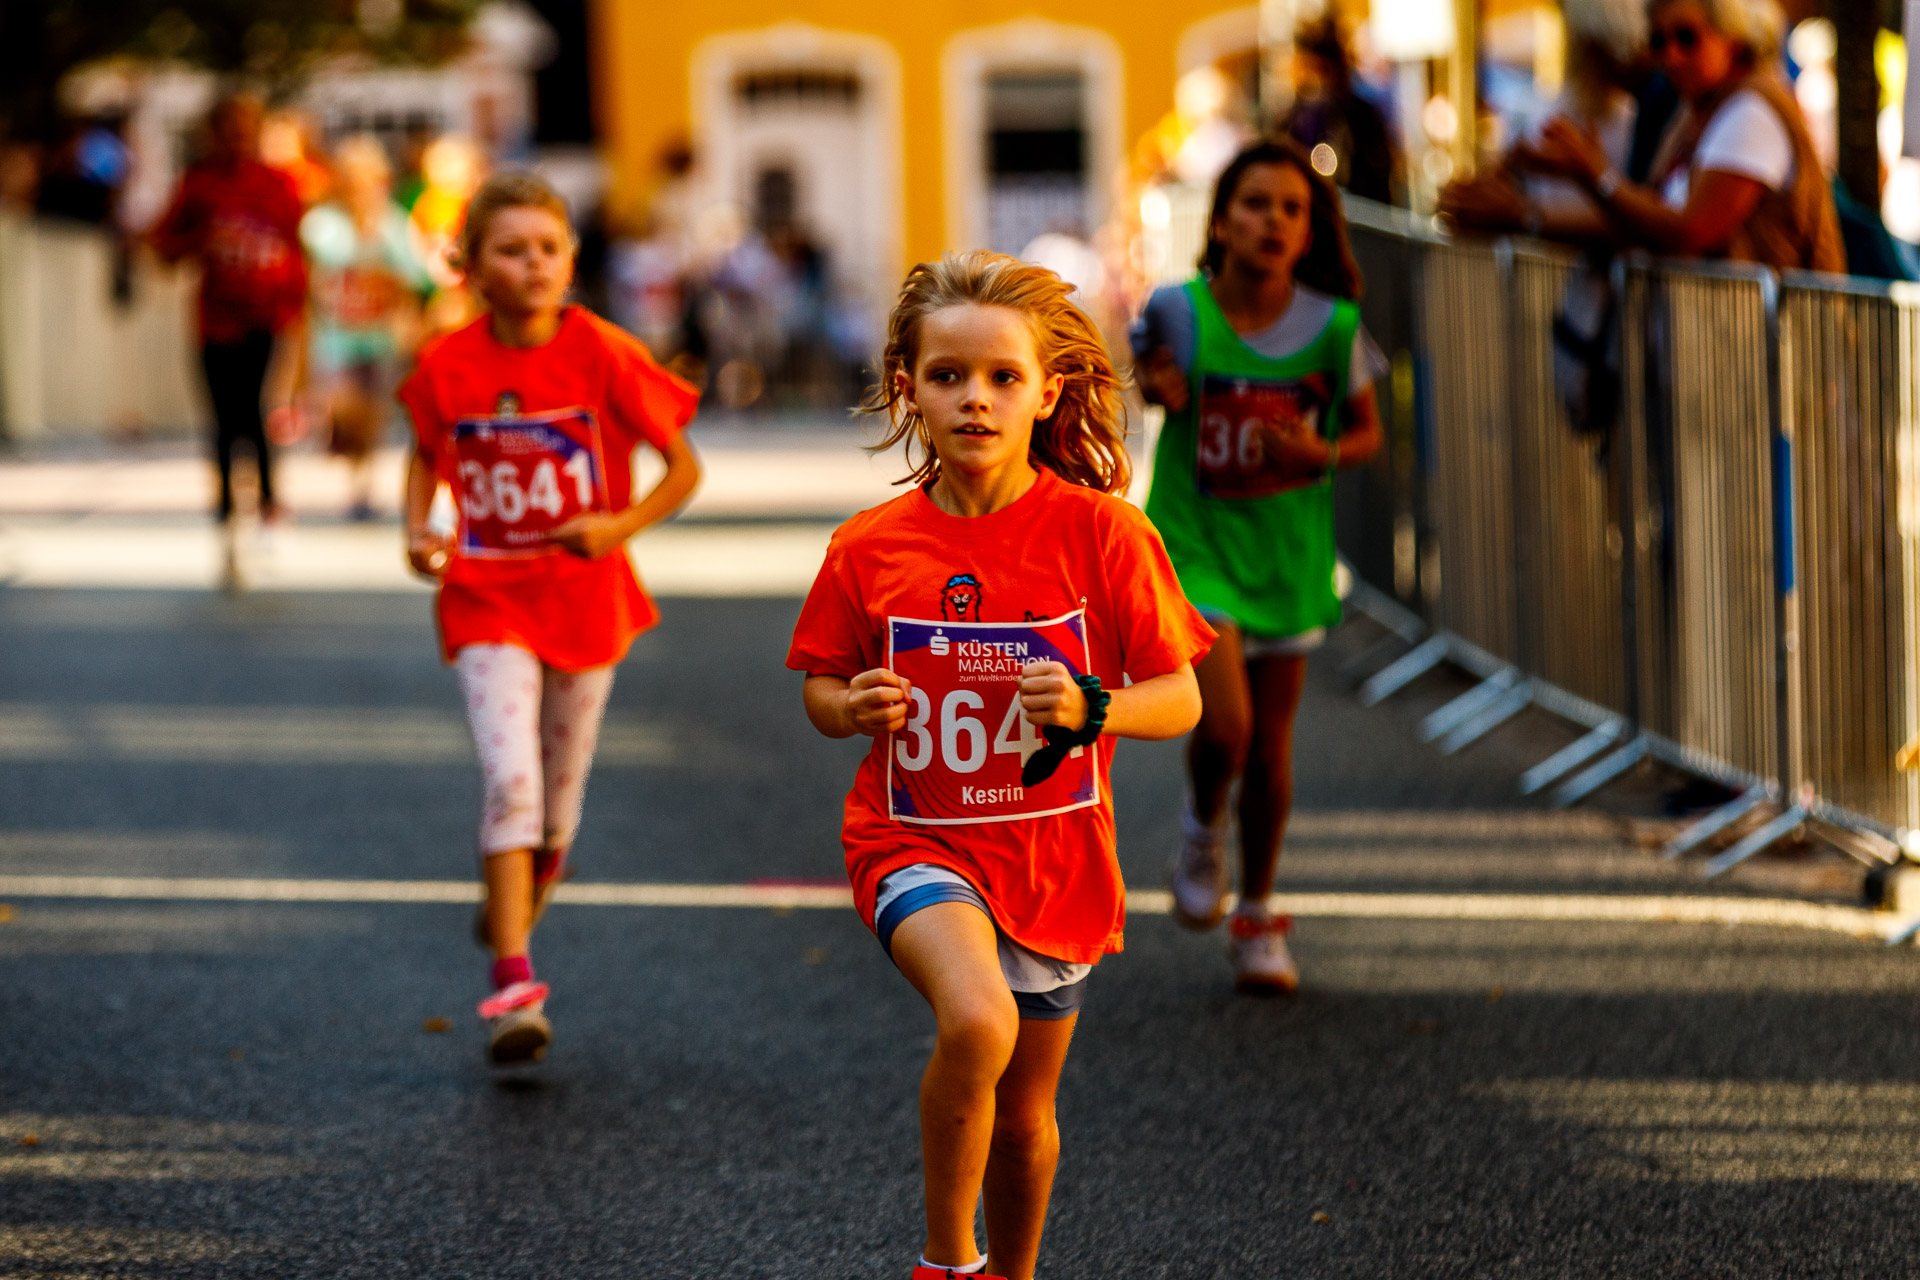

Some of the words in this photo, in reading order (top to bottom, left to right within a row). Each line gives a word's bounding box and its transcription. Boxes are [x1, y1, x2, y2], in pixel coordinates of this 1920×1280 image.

[458, 448, 593, 523] 3641
[958, 639, 1028, 656] KÜSTEN
[978, 674, 1020, 682] Weltkinde
[896, 686, 1083, 773] 364
[962, 784, 1024, 804] Kesrin
